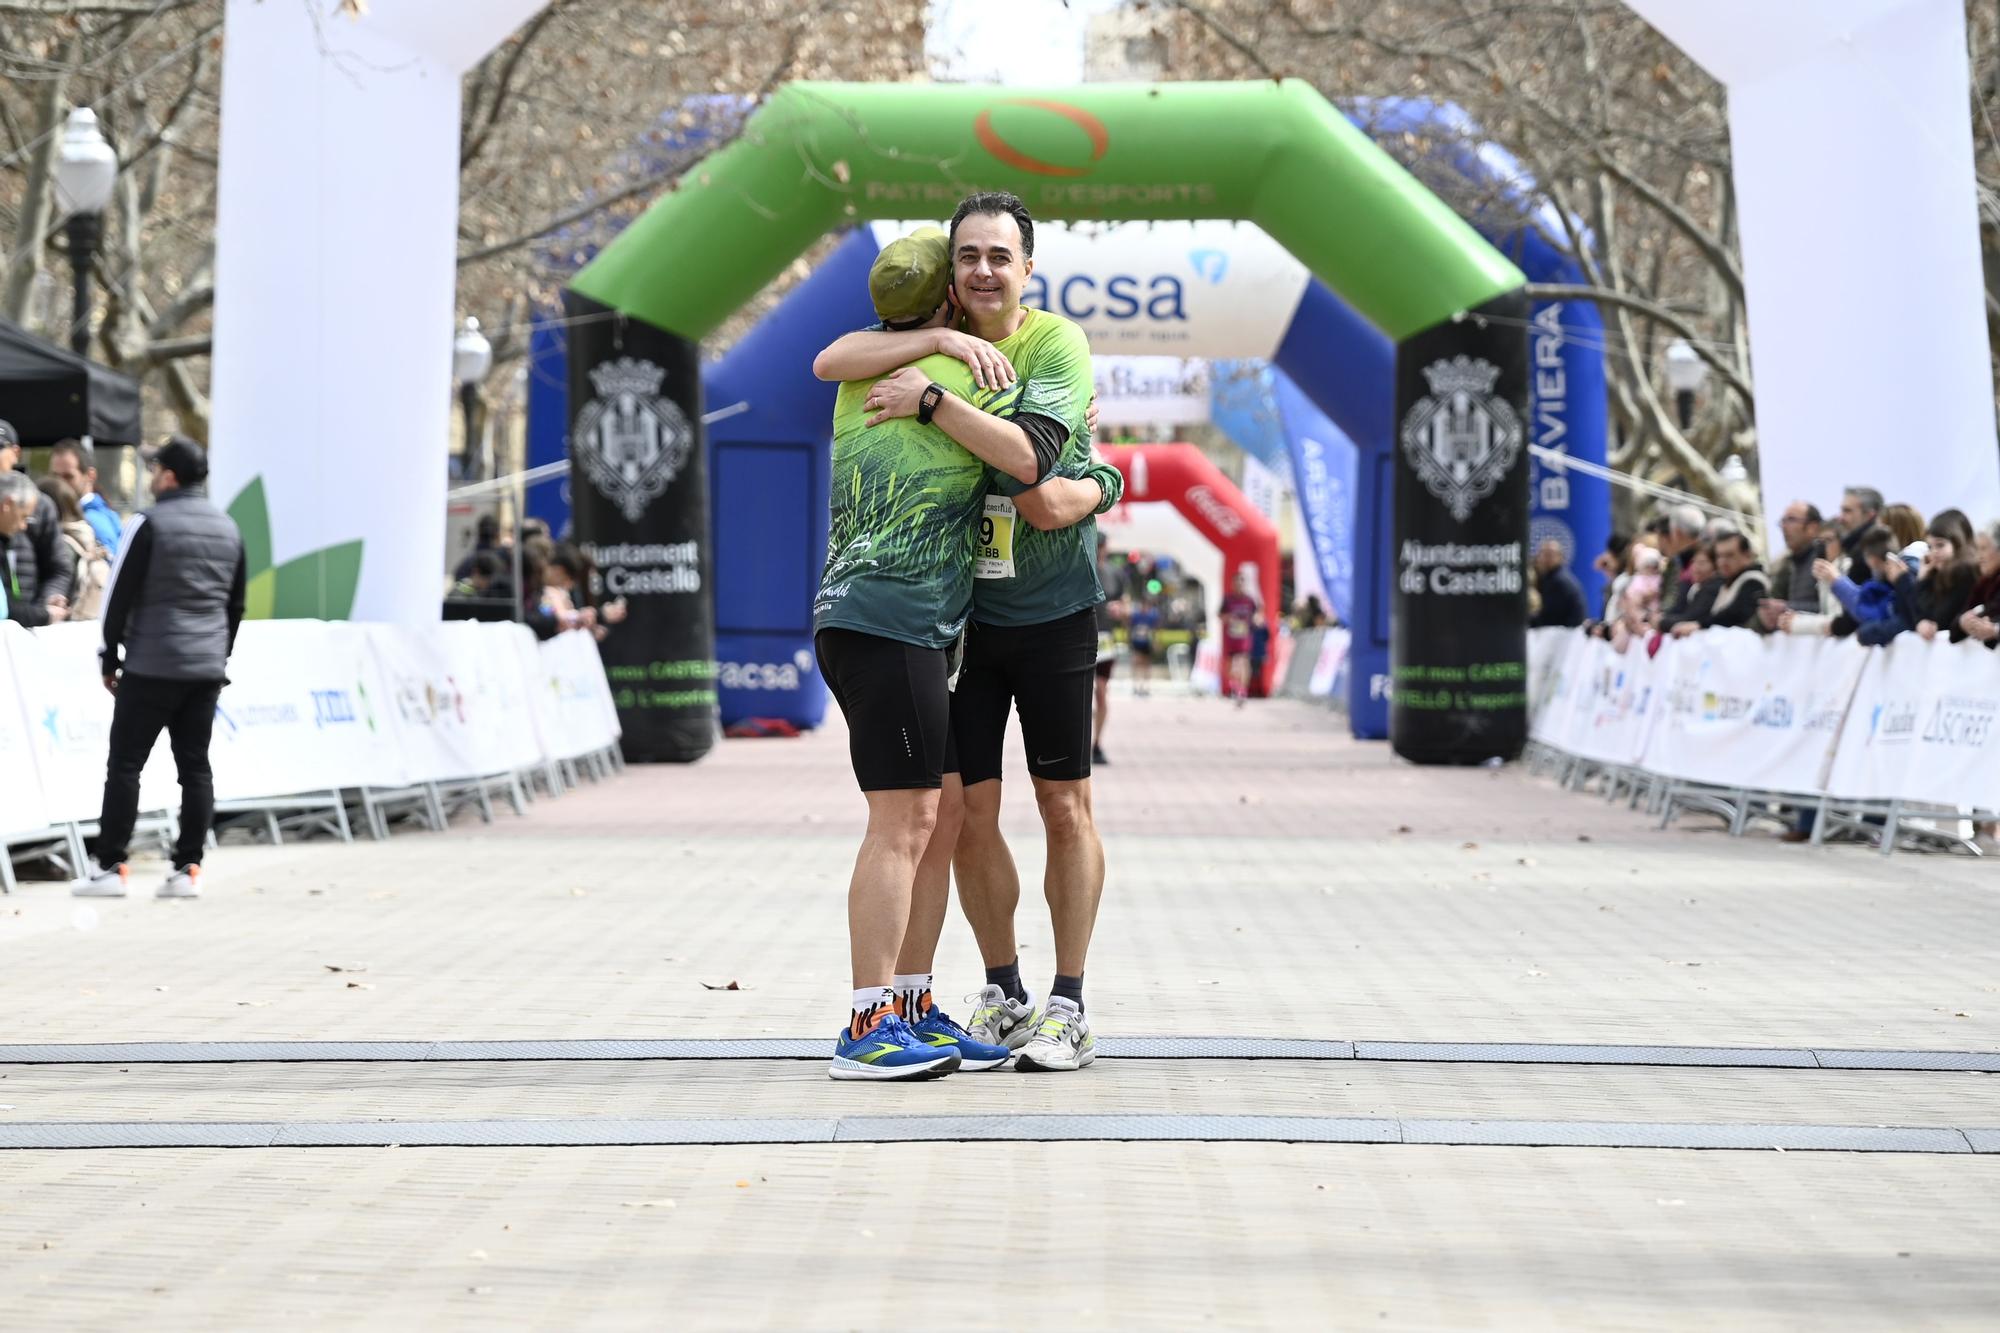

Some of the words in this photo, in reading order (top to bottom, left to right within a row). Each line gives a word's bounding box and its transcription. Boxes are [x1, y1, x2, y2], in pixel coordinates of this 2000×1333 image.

[1021, 271, 1189, 321] acsa
[1534, 301, 1571, 511] BAVIERA
[985, 547, 1000, 558] BB
[1400, 539, 1521, 569] Ajuntament
[1400, 566, 1426, 595] de
